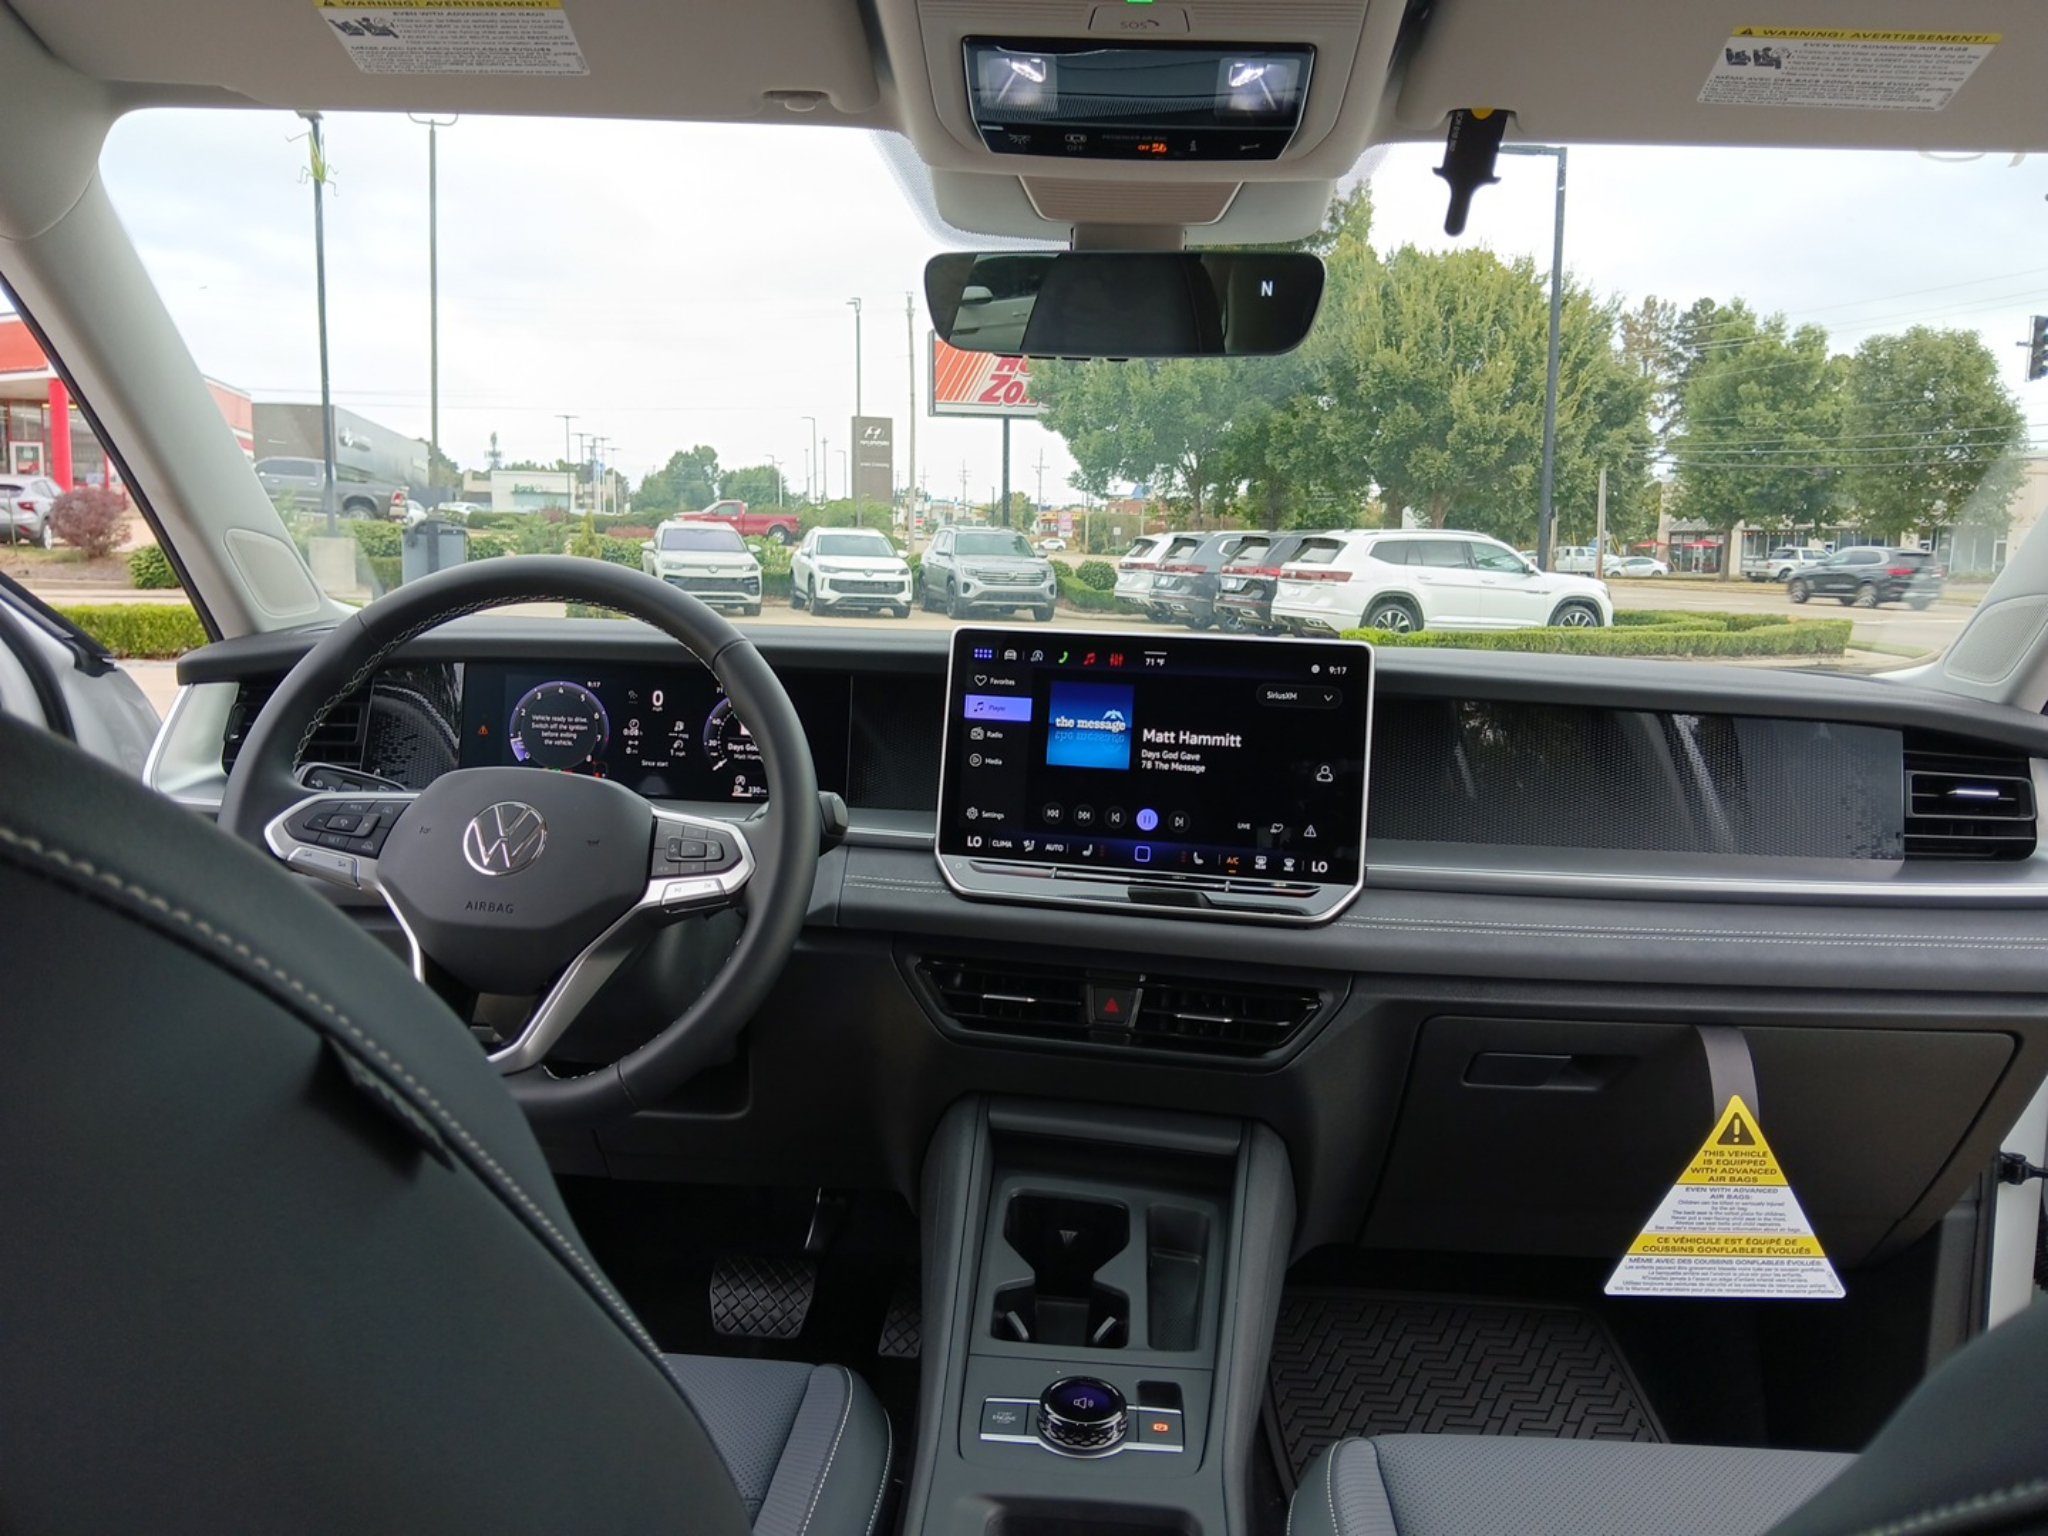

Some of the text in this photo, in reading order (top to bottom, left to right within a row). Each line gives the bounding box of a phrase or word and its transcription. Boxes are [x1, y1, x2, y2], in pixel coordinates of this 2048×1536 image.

[1120, 20, 1147, 30] SOS
[1763, 30, 1989, 43] WARNING! AVERTISSEMENT!
[1261, 281, 1273, 297] N
[1328, 666, 1348, 675] 9:17
[990, 678, 1015, 686] Favorites
[558, 686, 564, 694] 4
[580, 694, 586, 702] 5
[652, 690, 664, 707] 0
[1266, 691, 1298, 701] SiriusXM
[521, 708, 526, 716] 2
[594, 712, 600, 720] 6
[1055, 716, 1126, 734] the message
[986, 731, 1004, 739] Radio
[1142, 728, 1243, 748] Matt Hammitt
[1141, 750, 1201, 761] Days God Gave
[985, 758, 1003, 766] Media
[1154, 762, 1170, 770] The
[1171, 762, 1206, 774] Message
[982, 810, 1005, 821] Settings
[1237, 822, 1251, 830] LIVE
[966, 836, 1064, 852] LO CLIMA AUTO
[1226, 856, 1240, 866] A/C
[1312, 861, 1328, 873] LO
[464, 900, 515, 914] AIRBAG
[1703, 1150, 1768, 1159] THIS VEHICLE
[1703, 1158, 1767, 1167] IS EQUIPPED
[1690, 1167, 1718, 1175] WITH
[1680, 1236, 1722, 1245] VÉHICULE
[1724, 1237, 1743, 1245] EST
[1745, 1236, 1782, 1246] ÉQUIPÉ
[1784, 1238, 1798, 1246] DE
[1642, 1245, 1811, 1255] COUSSINS GONFLABLES ÉVOLUÉS
